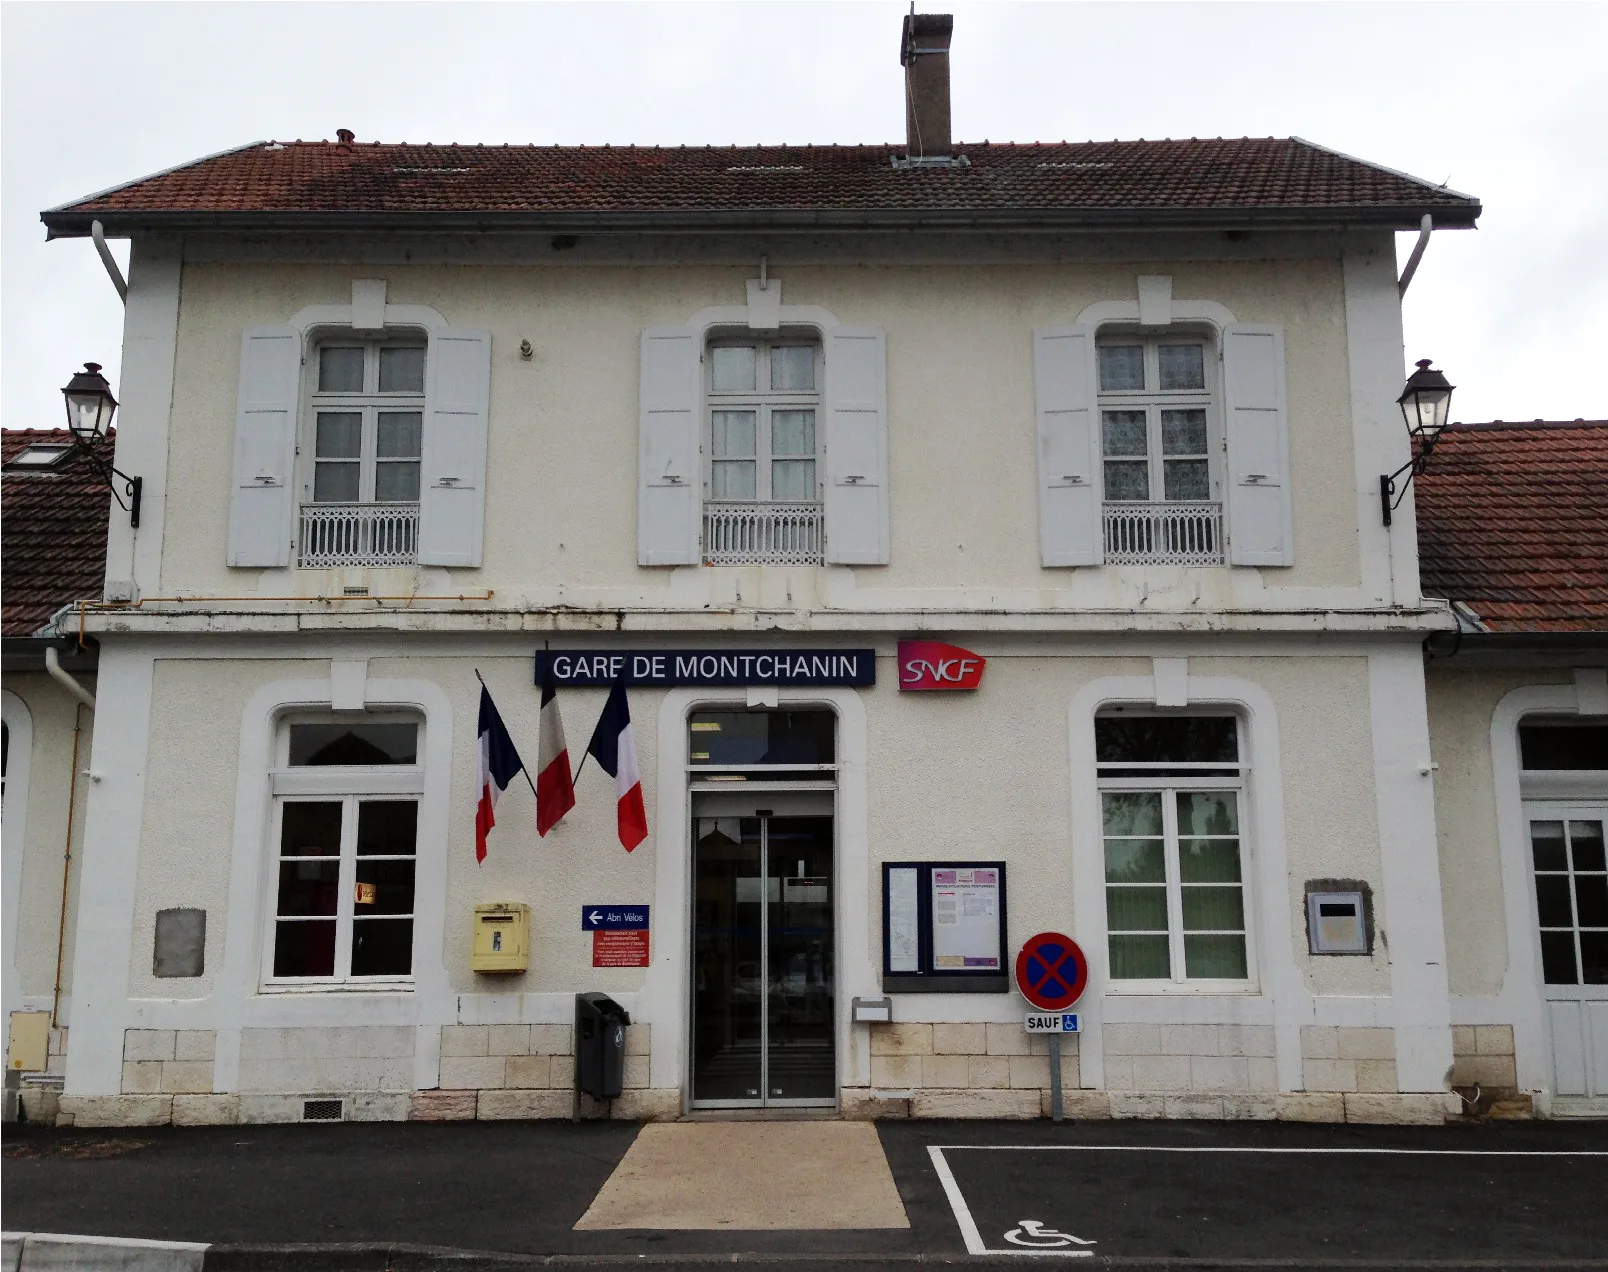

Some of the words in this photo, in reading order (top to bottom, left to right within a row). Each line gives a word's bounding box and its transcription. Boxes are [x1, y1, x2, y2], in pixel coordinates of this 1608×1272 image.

[553, 656, 624, 679] GARE
[633, 656, 666, 678] DE
[675, 655, 858, 678] MONTCHANIN
[903, 658, 979, 683] SNCF
[606, 912, 622, 922] Abri
[1028, 1017, 1060, 1029] SAUF
